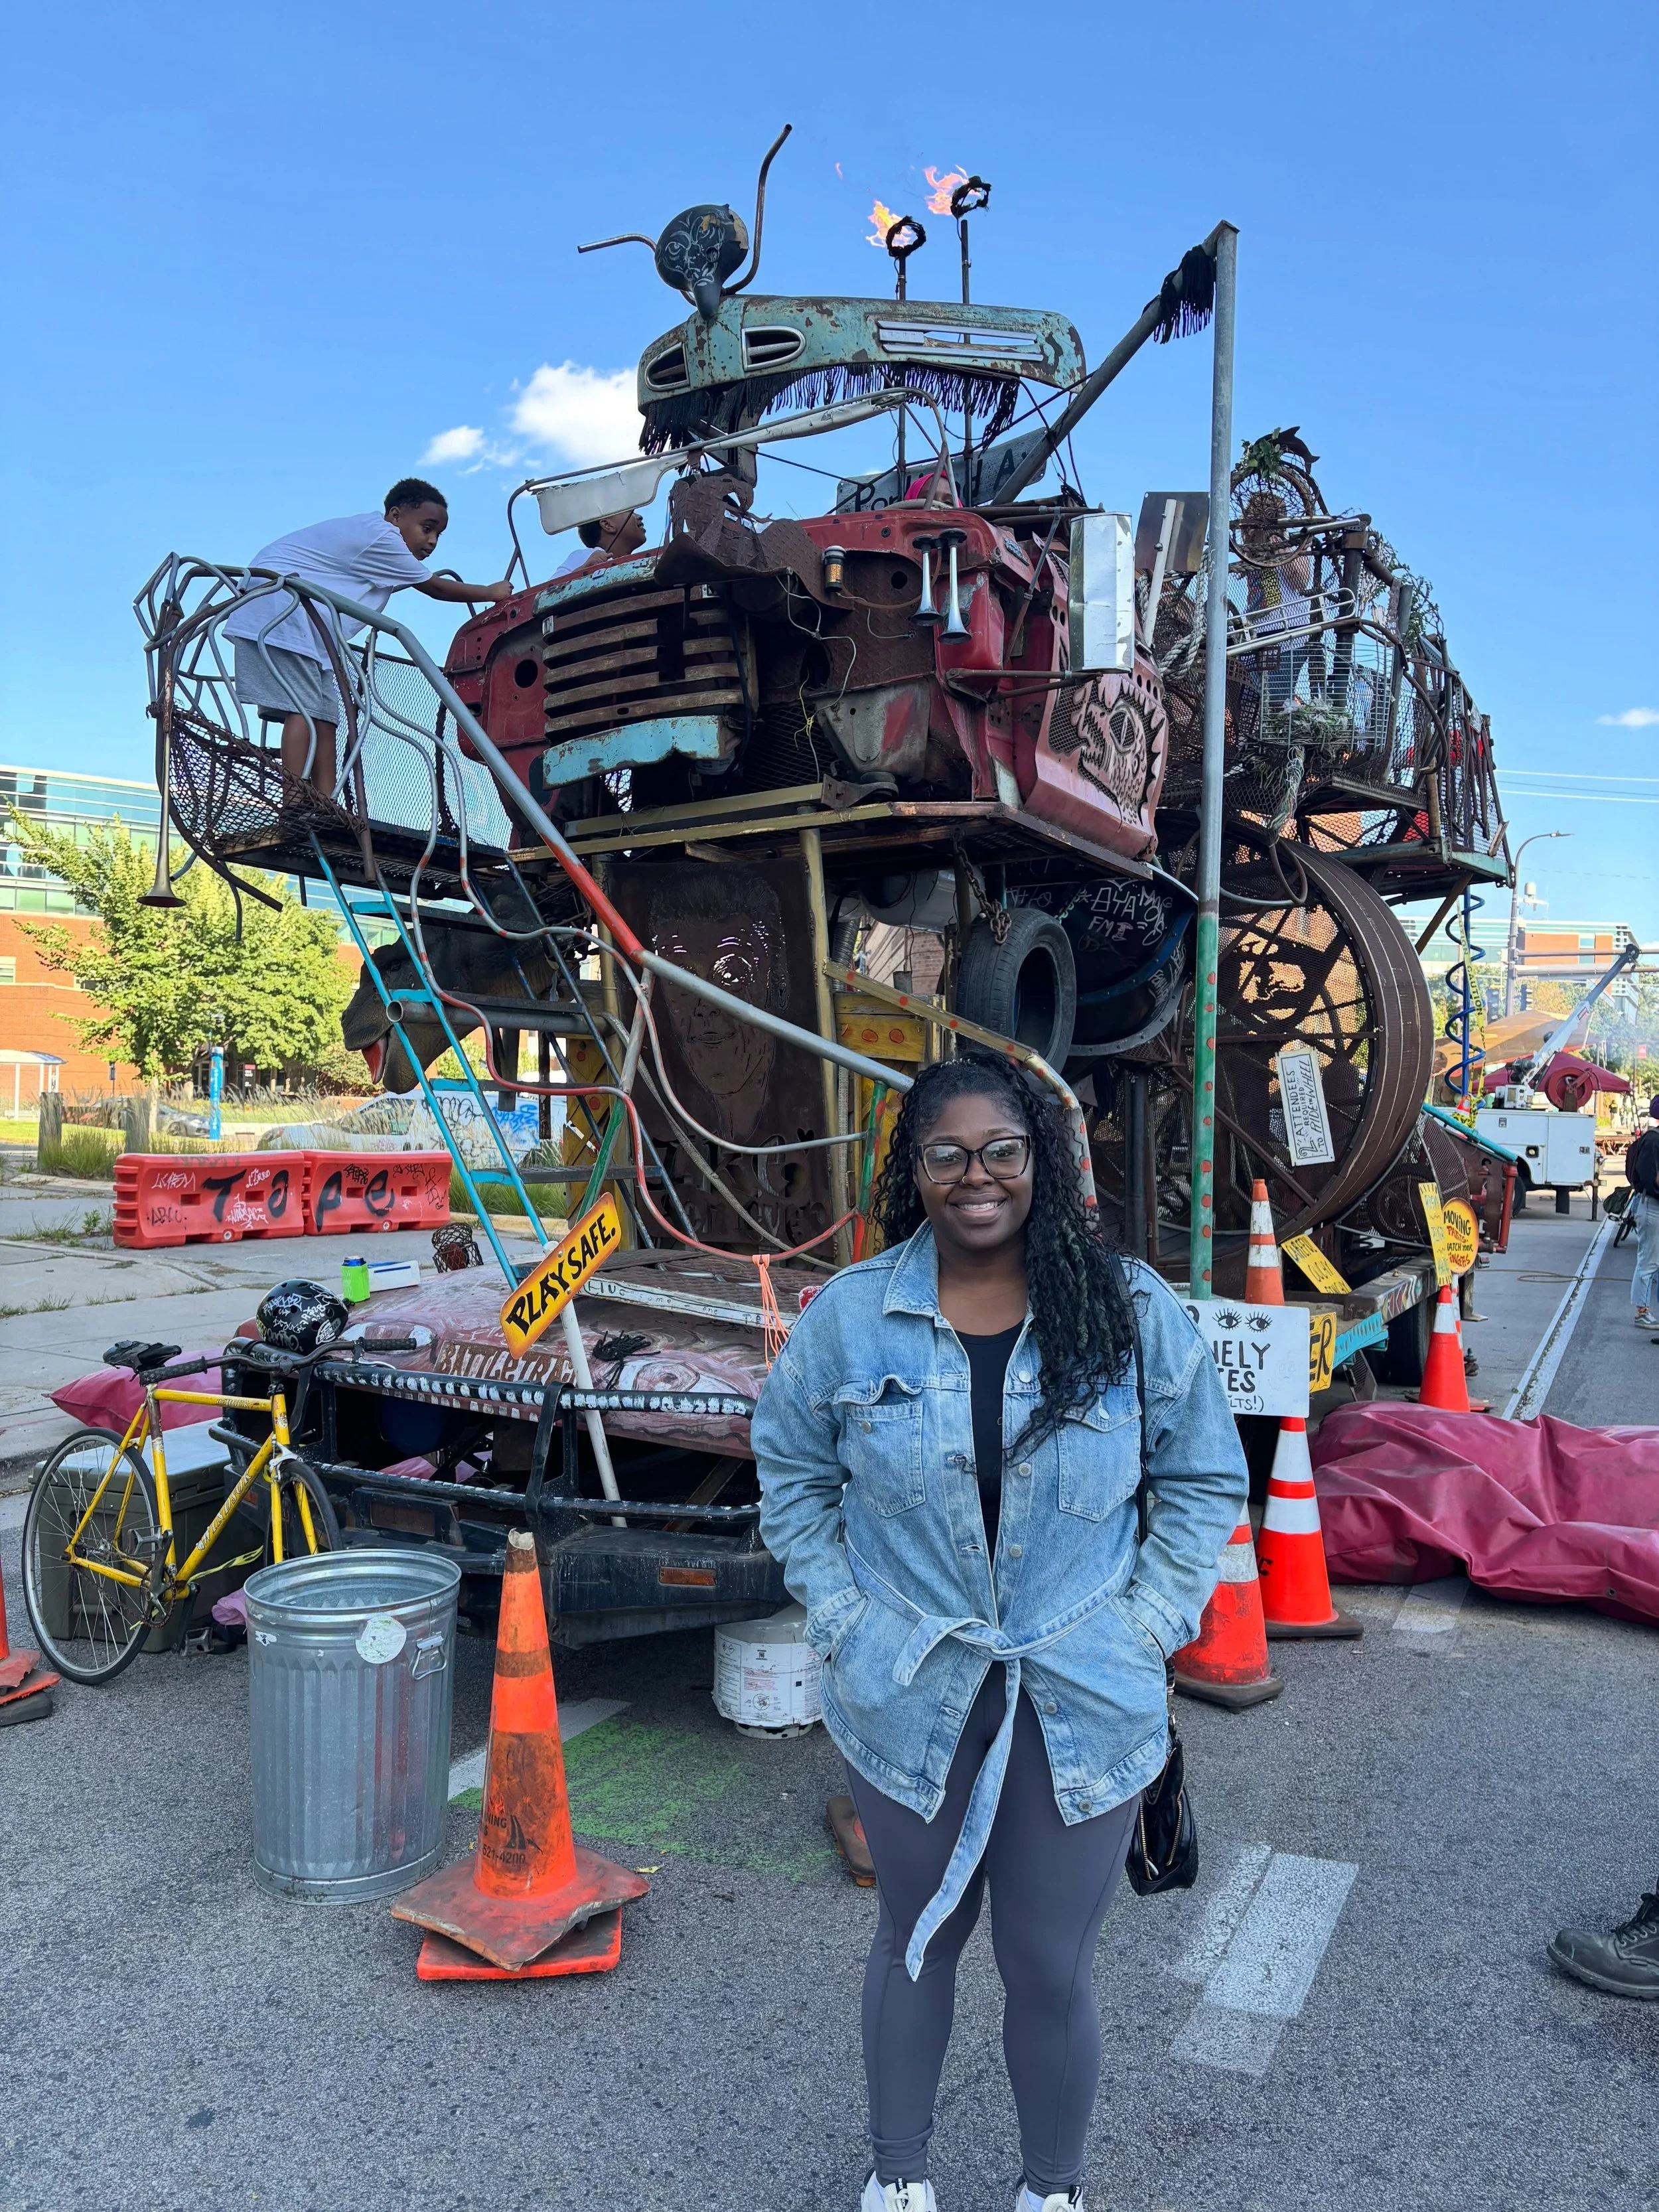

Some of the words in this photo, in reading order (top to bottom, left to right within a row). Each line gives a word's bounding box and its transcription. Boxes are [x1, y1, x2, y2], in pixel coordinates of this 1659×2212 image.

[1467, 966, 1483, 1015] CAUTION
[1299, 1060, 1317, 1099] WHEEL
[1286, 1070, 1305, 1136] ATTENDEES
[1299, 1086, 1310, 1126] REQUIRED
[1308, 1105, 1322, 1134] RIDE
[1317, 1137, 1325, 1148] TO
[1443, 1210, 1472, 1236] MOVING
[506, 1260, 570, 1337] PLAY
[567, 1213, 616, 1280] SAFE.
[1448, 1252, 1471, 1267] INGERS
[196, 1468, 257, 1550] WINDSOR
